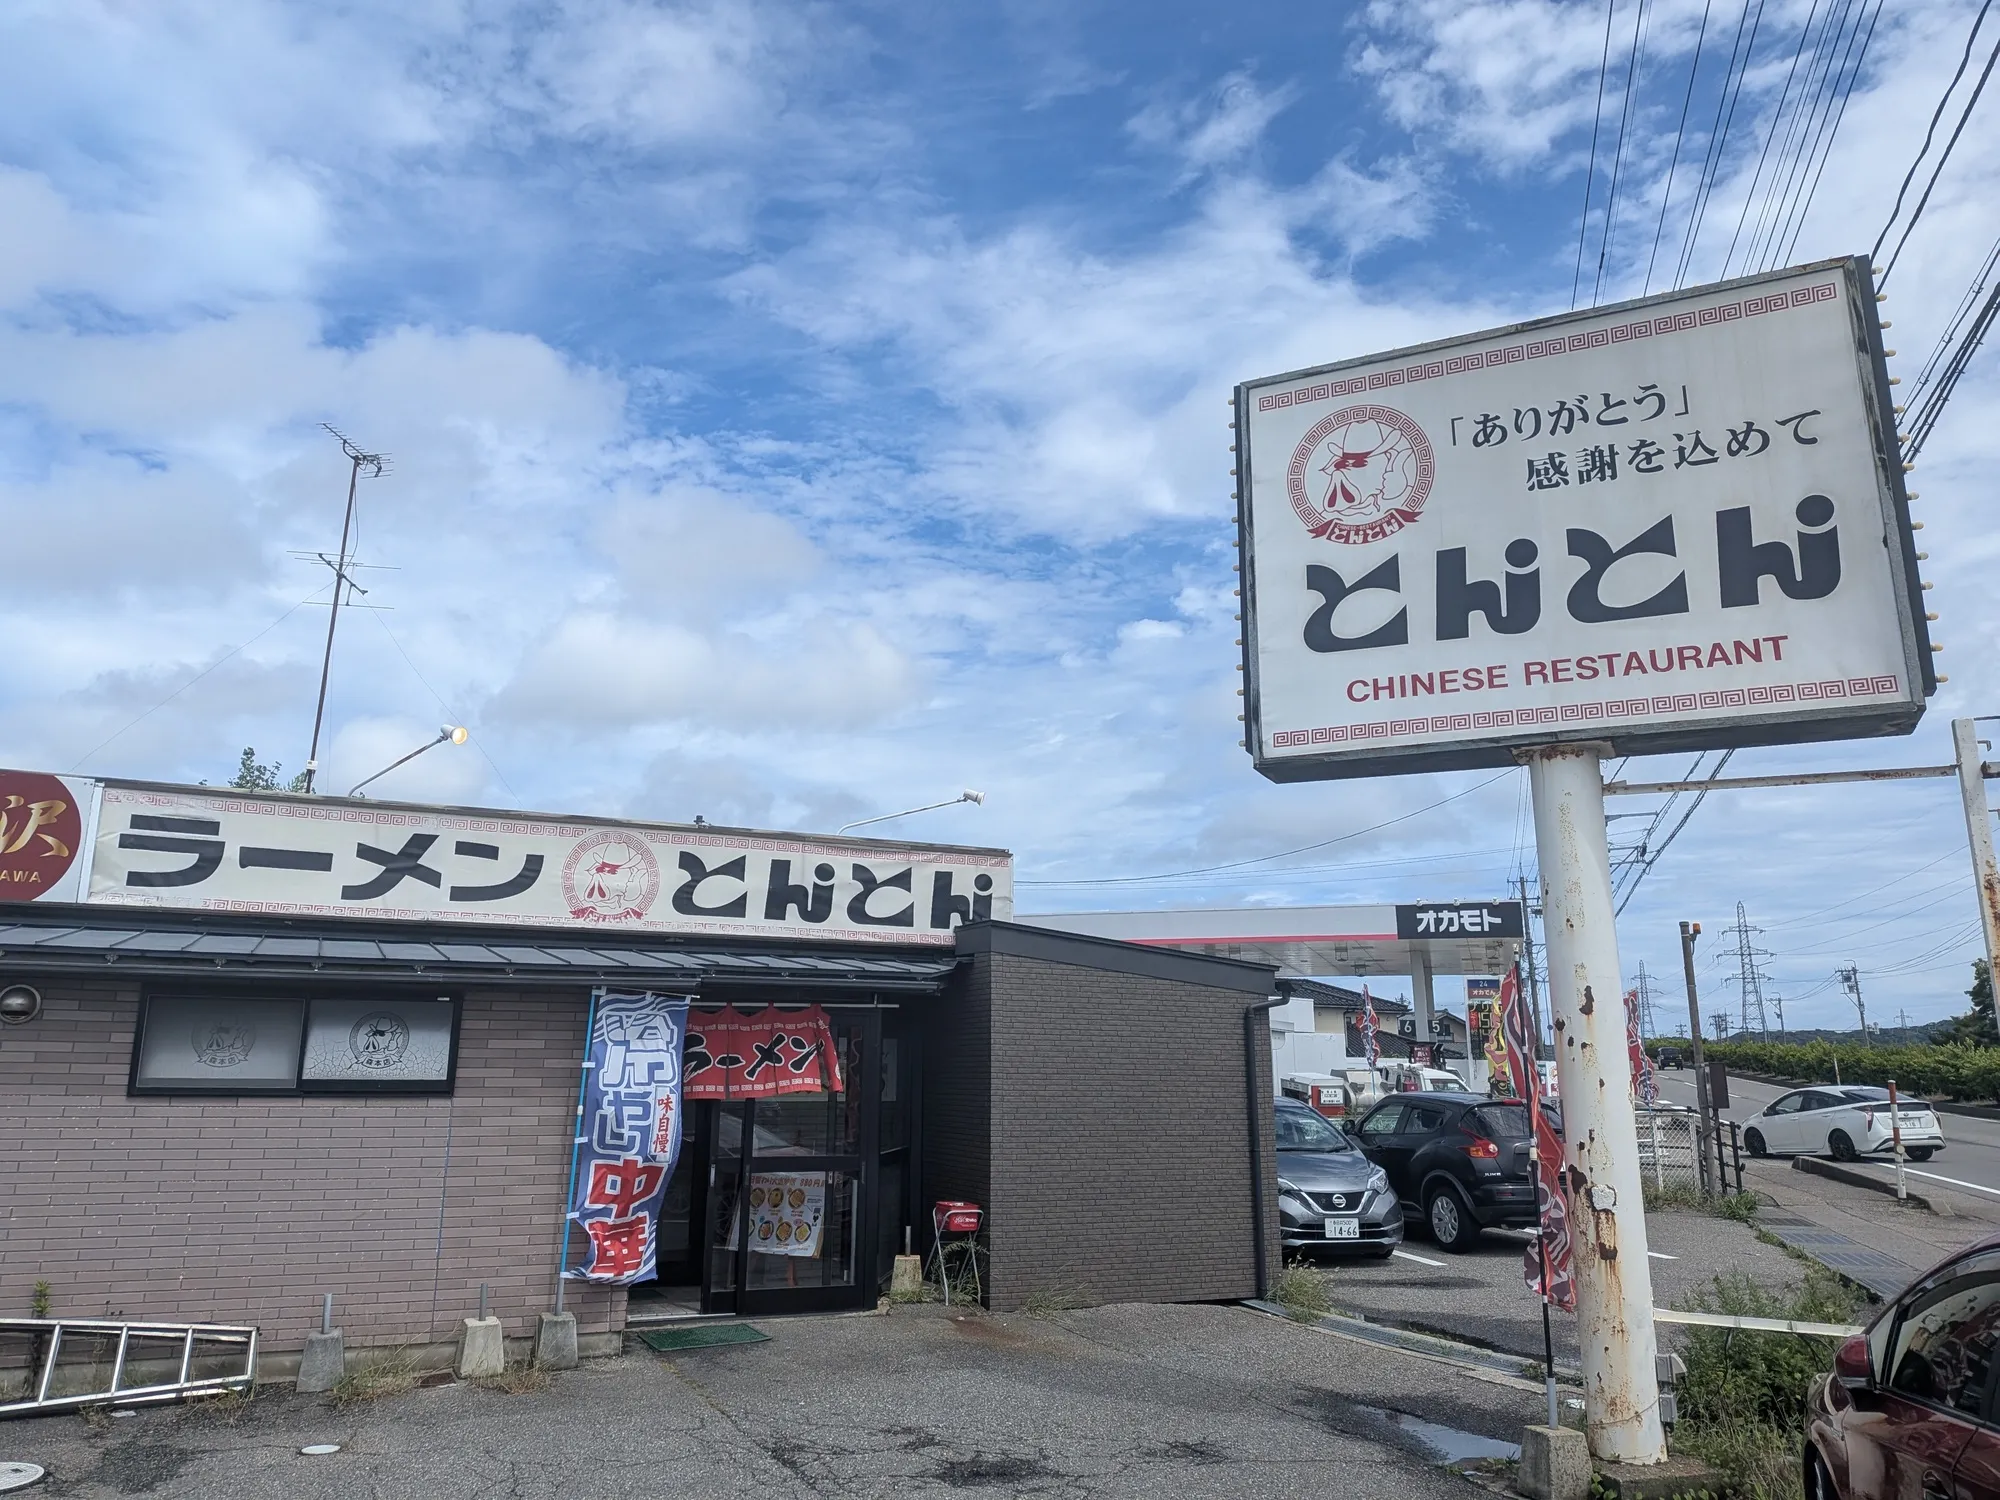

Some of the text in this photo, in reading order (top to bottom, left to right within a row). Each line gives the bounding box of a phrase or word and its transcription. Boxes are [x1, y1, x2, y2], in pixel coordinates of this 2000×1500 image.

[1449, 384, 1692, 448] 「ありがとう」
[1525, 408, 1823, 491] 感謝を込めて
[1302, 494, 1842, 654] とんとん
[1345, 634, 1790, 704] CHINESE RESTAURANT
[118, 813, 994, 930] ラーメン とんとん
[1416, 908, 1502, 933] オカモト
[1404, 1020, 1412, 1033] 6
[1432, 1020, 1440, 1033] 5
[652, 1094, 675, 1154] 味自慢
[1333, 1226, 1358, 1237] 14-66
